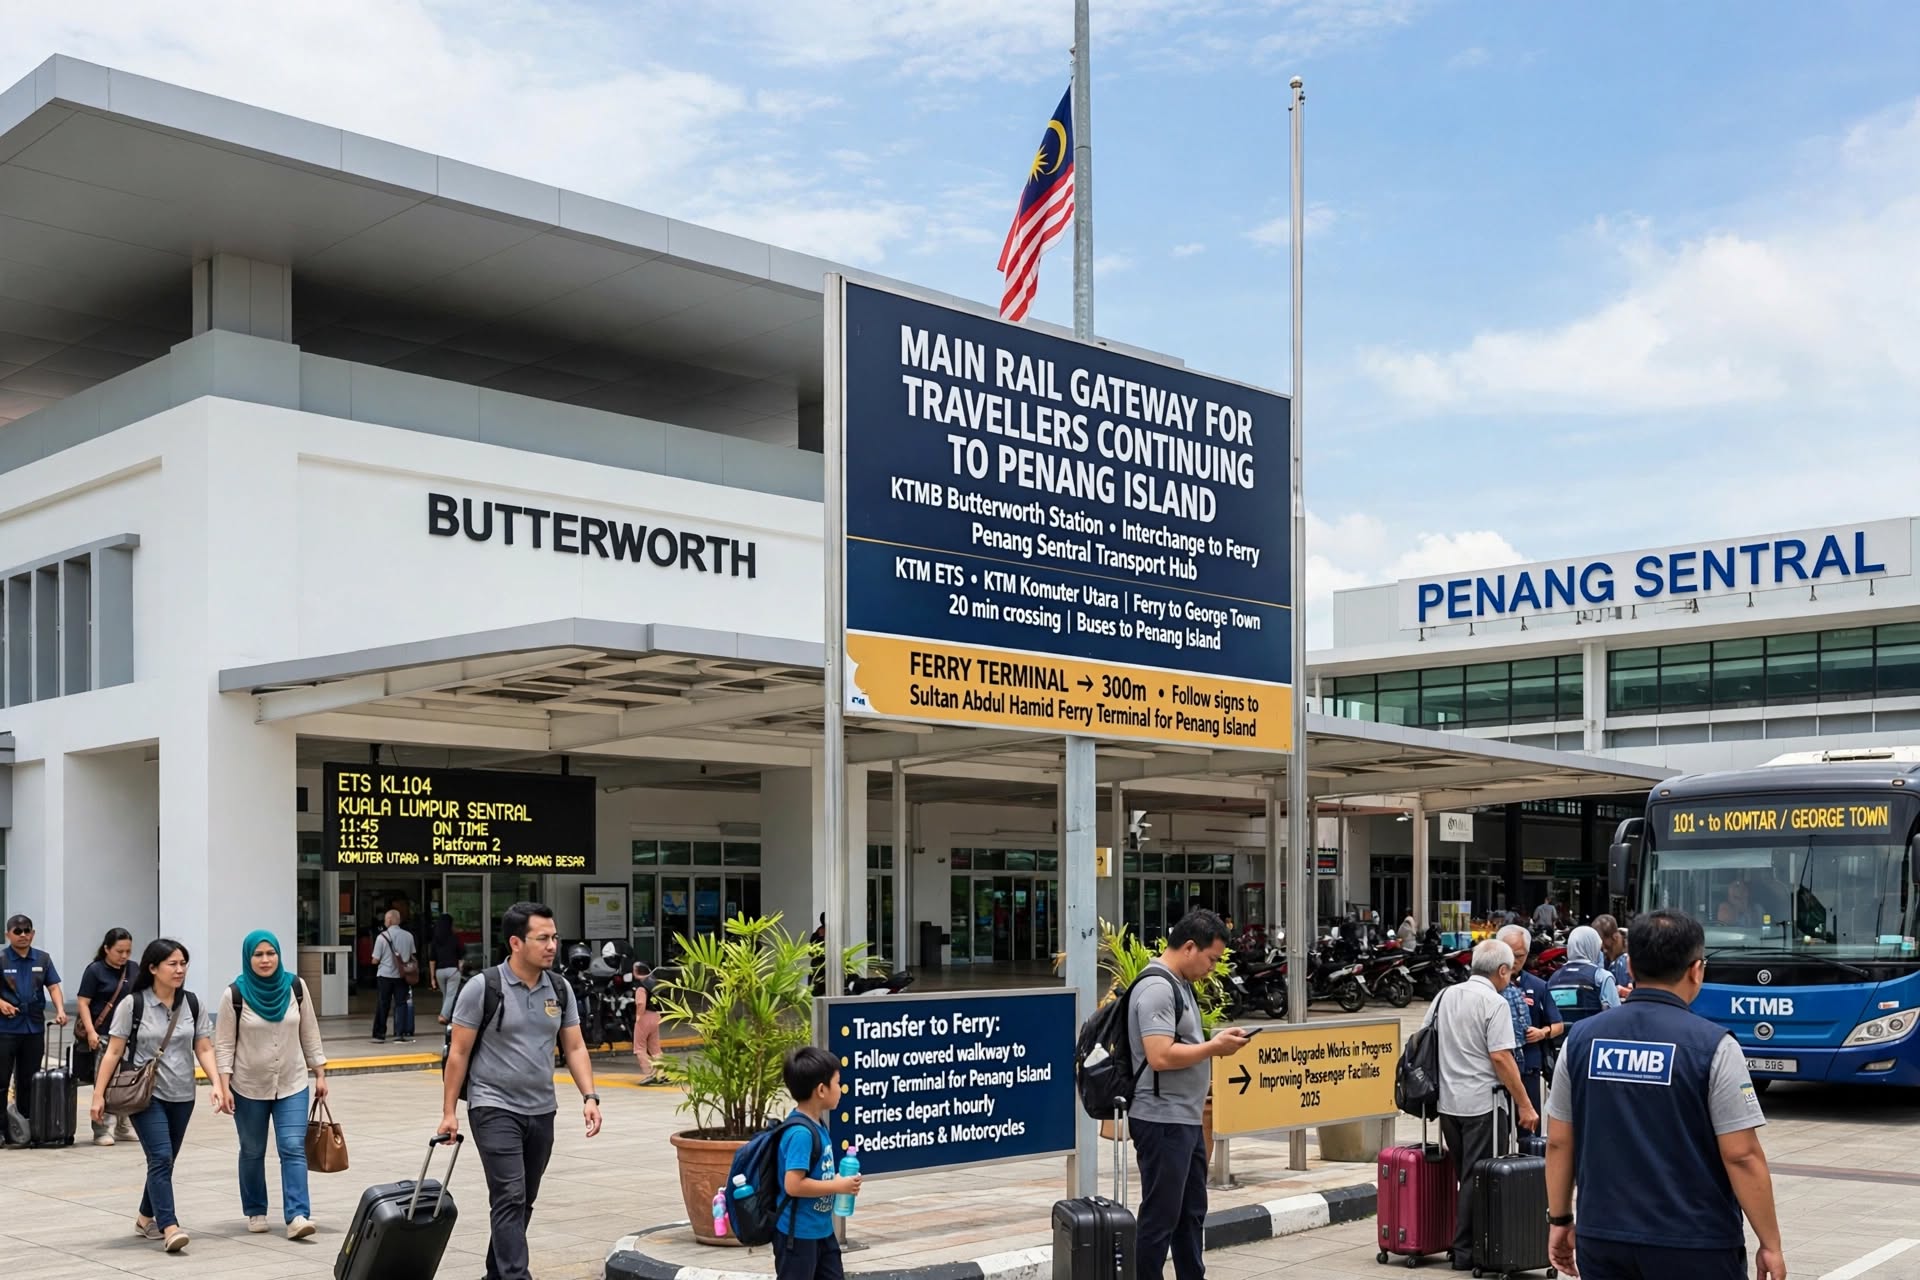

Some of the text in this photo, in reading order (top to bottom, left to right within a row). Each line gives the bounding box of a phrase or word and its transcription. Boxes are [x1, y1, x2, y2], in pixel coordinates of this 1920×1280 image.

[902, 325, 1252, 446] MAIN RAIL GATEWAY FOR
[903, 375, 1253, 488] TRAVELLERS CONTINUING
[948, 434, 1216, 522] TO PENANG ISLAND
[429, 493, 755, 578] BUTTERWORTH
[892, 477, 1259, 568] KTMB Butterworth Station Interchange to Ferry
[973, 523, 1197, 580] Penang Sentral Transport Hub
[1418, 532, 1884, 621] PENANG SENTRAL
[896, 557, 930, 581] KTM
[936, 563, 964, 586] ETS
[985, 570, 1015, 593] KTM
[1021, 576, 1079, 602] Komuter
[1083, 586, 1118, 608] Utara
[1134, 594, 1166, 620] Ferry
[1168, 601, 1181, 617] to
[1185, 602, 1227, 628] George
[1230, 609, 1260, 629] Town
[950, 594, 968, 615] 20
[973, 599, 998, 619] min
[1003, 606, 1060, 633] crossing
[1078, 612, 1116, 635] Buses
[1119, 620, 1132, 637] to
[1137, 619, 1182, 649] Penang
[1187, 625, 1220, 649] Island
[911, 652, 1258, 714] FERRY TERMINAL 300m Follow signs to
[911, 684, 1257, 737] Sultan Abdul Hamid Ferry Terminal for Penang Island
[339, 773, 432, 795] ETS KL104
[339, 797, 531, 821] KUALA LUMPUR SENTRAL
[1674, 814, 1694, 832] 101
[1708, 816, 1720, 831] to
[1725, 810, 1776, 831] KOMTAR
[1791, 808, 1844, 828] GEORGE
[1849, 806, 1887, 826] TOWN
[341, 818, 488, 836] 11:45 ON TIME
[341, 835, 500, 851] 11:52 Platform 2
[338, 851, 585, 867] KOMUTER UTARA BUTTERWORTH PADANG BESAR
[1732, 997, 1793, 1015] KTMB
[853, 1013, 999, 1039] Transfer to Ferry:
[855, 1042, 1025, 1069] Follow covered walkway to
[1327, 1042, 1350, 1058] Works
[1353, 1042, 1359, 1055] in
[1362, 1041, 1392, 1060] Progress
[1596, 1046, 1665, 1073] KTMB
[855, 1063, 1050, 1099] Ferry Terminal for Penang Island
[1260, 1070, 1302, 1092] Improving
[855, 1094, 994, 1124] Ferries depart hourly
[1301, 1091, 1320, 1107] 2025
[854, 1119, 1024, 1152] Pedestrians & Motorcycles
